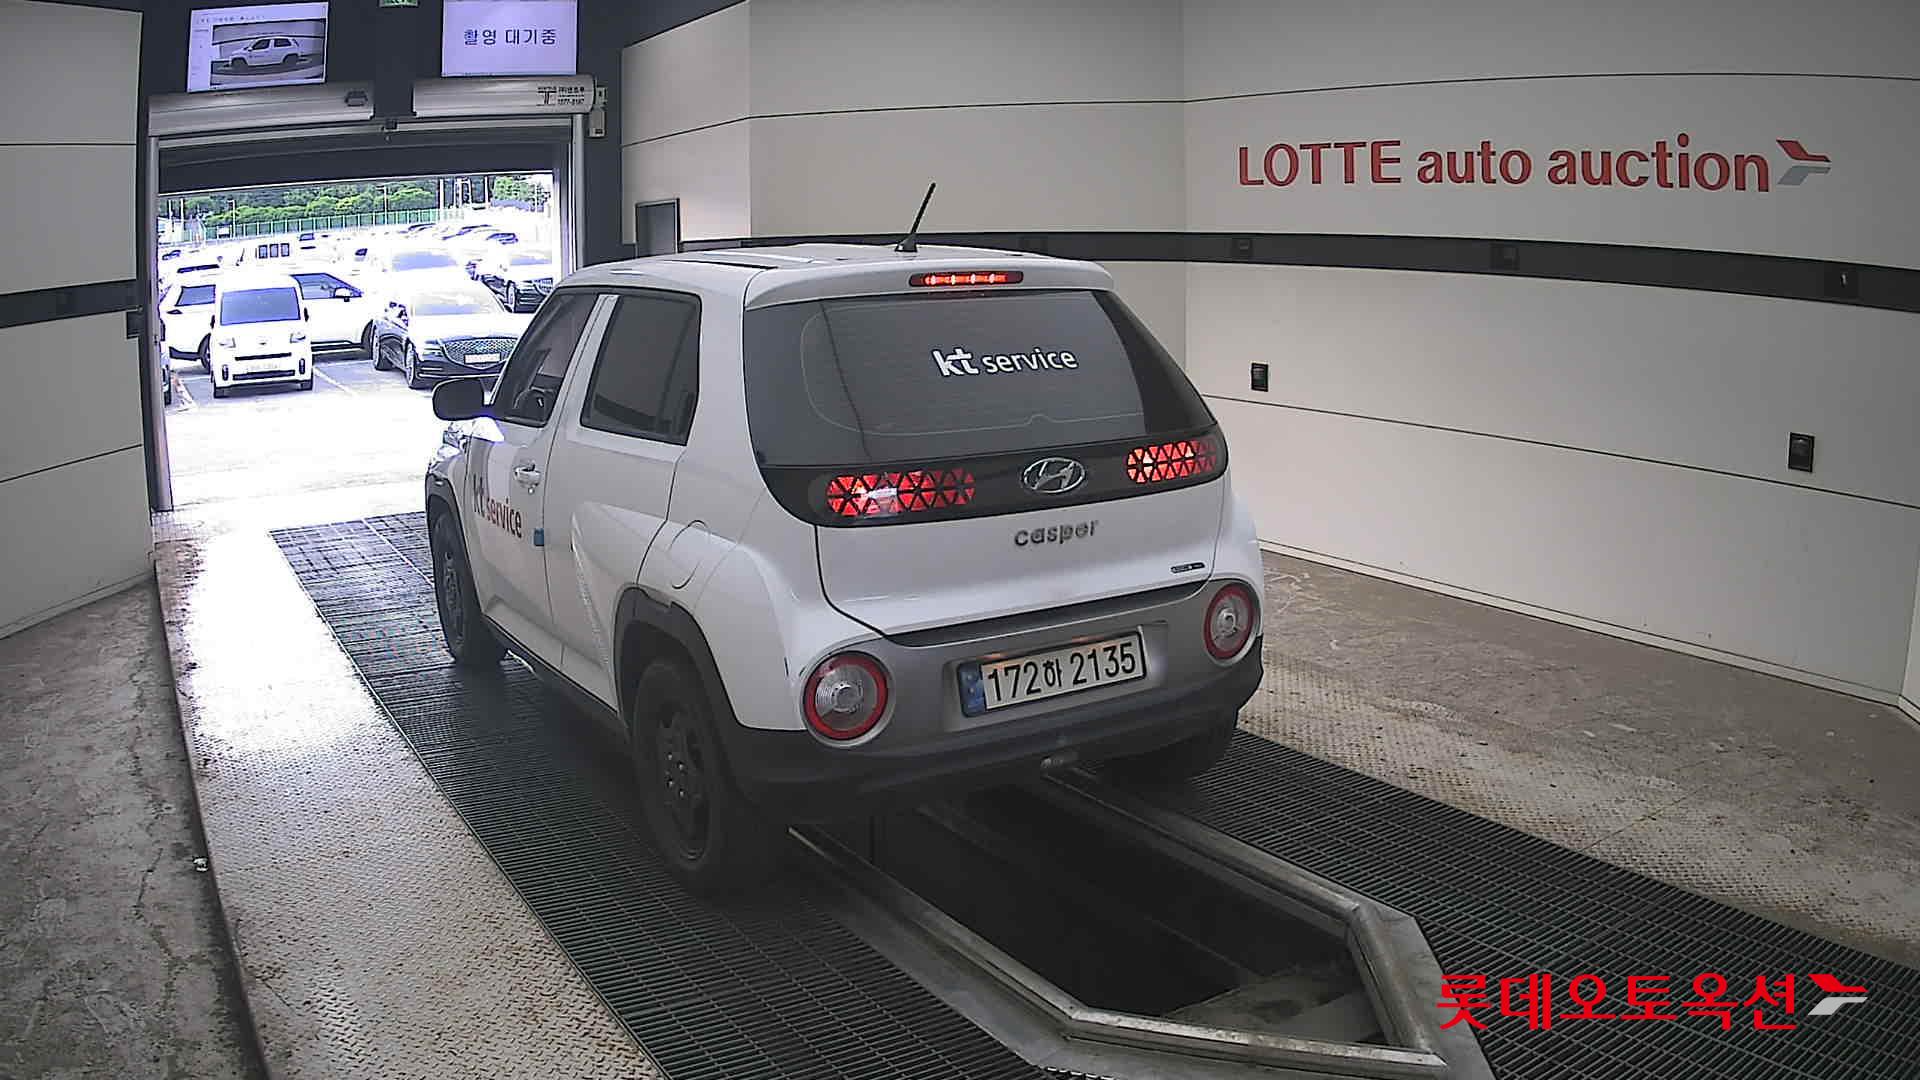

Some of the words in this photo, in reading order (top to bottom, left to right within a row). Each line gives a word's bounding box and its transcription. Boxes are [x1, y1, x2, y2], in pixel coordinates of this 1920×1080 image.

[505, 29, 556, 45] 대기중
[1238, 140, 1401, 187] LOTTE
[1416, 140, 1532, 185] auto
[1547, 132, 1769, 193] auction
[932, 348, 979, 377] kt
[982, 348, 1078, 374] service
[486, 497, 522, 539] service
[1014, 519, 1098, 547] casper
[987, 658, 1063, 702] 172하
[1070, 642, 1136, 686] 2135
